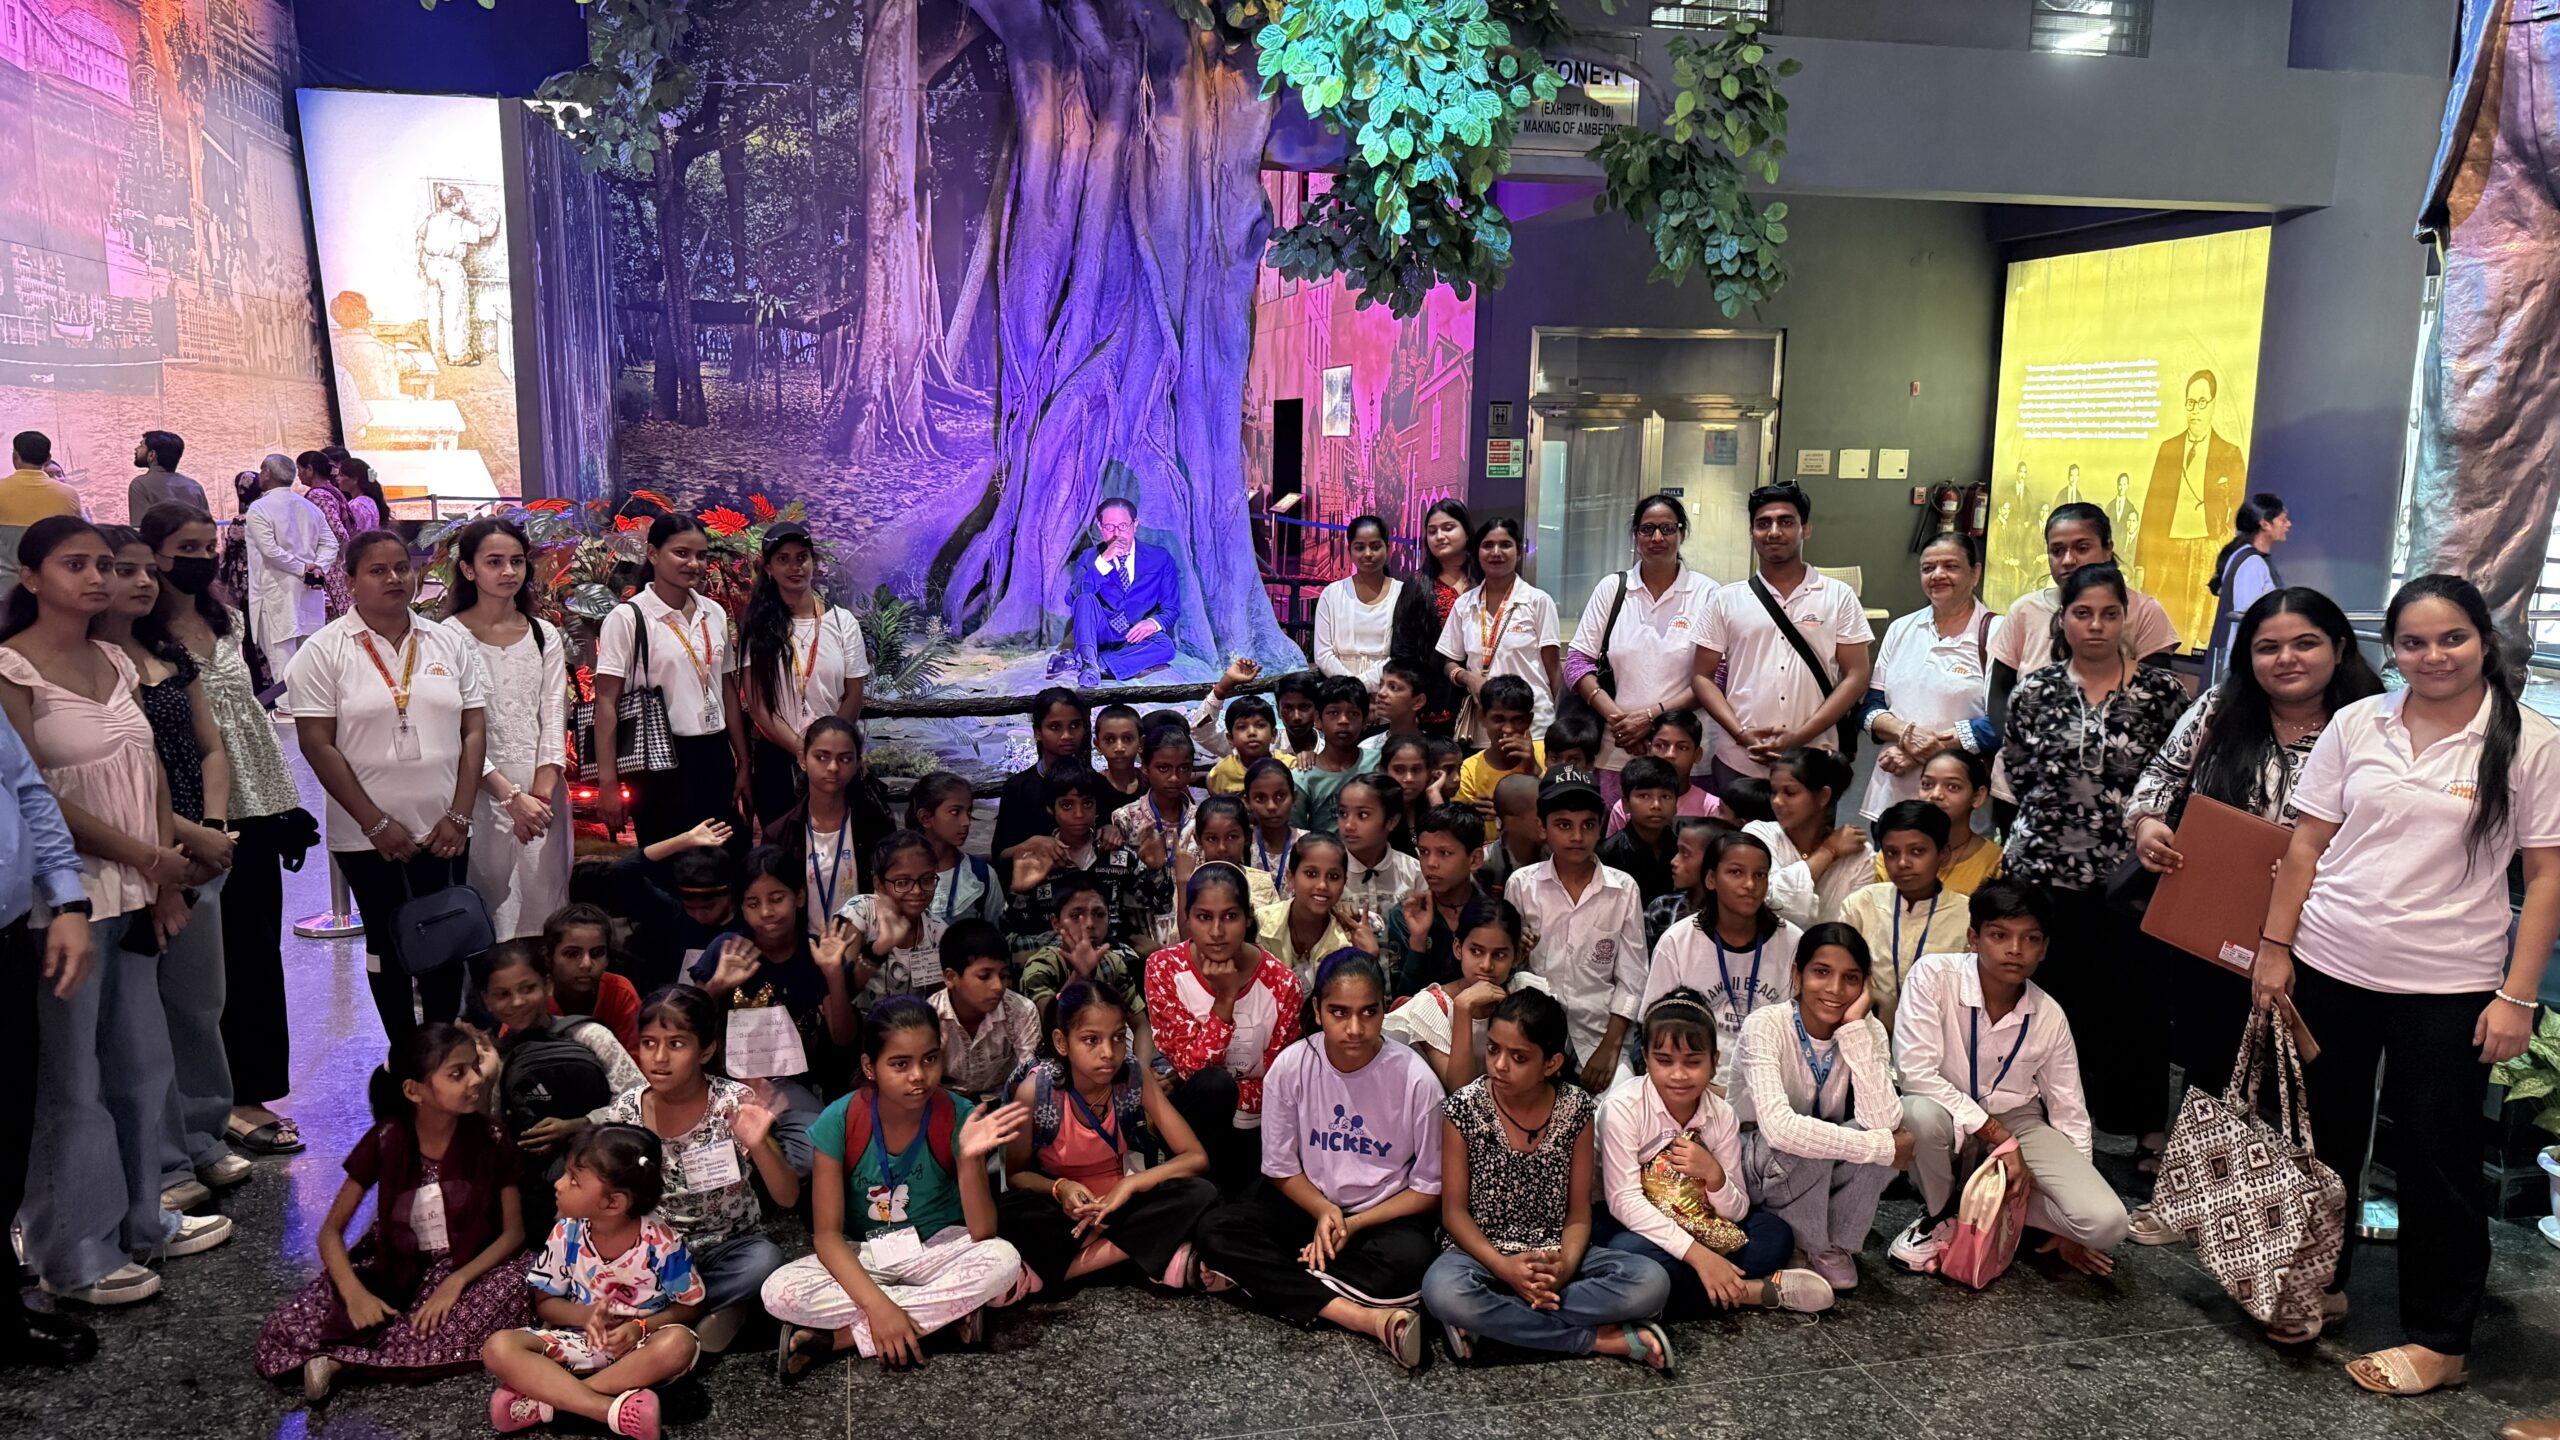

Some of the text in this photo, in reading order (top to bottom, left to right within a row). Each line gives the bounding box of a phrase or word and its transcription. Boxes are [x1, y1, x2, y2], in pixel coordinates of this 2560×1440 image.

[1541, 102, 1614, 121] (EXHIBIT 1 to 10)
[1523, 120, 1560, 135] MAKING
[1562, 121, 1576, 135] OF
[1555, 771, 1591, 784] KING
